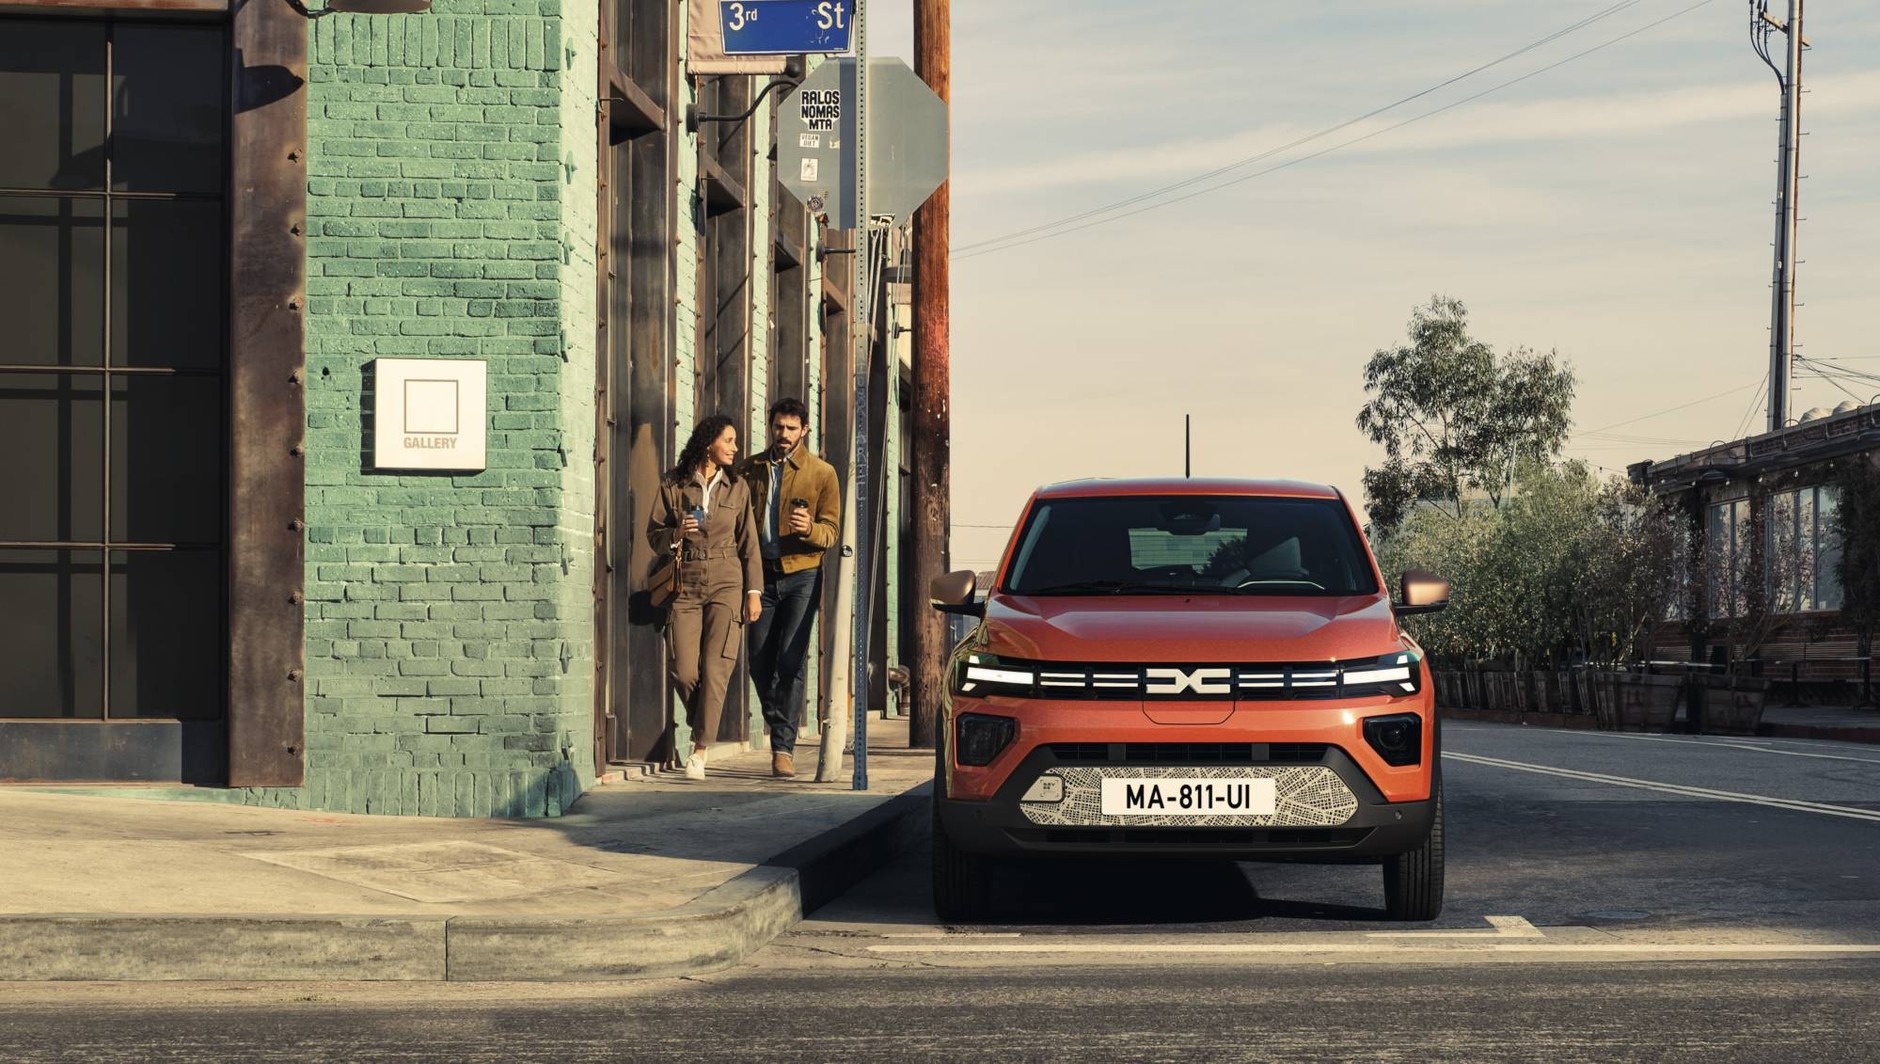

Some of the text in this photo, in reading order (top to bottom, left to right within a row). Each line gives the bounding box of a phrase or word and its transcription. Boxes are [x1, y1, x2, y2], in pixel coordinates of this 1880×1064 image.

[729, 1, 845, 31] 3rd St
[801, 90, 840, 105] RALOS
[801, 105, 840, 119] NOMAS
[808, 118, 832, 130] MTA
[403, 437, 458, 449] GALLERY
[1126, 784, 1250, 809] MA-811-UI
